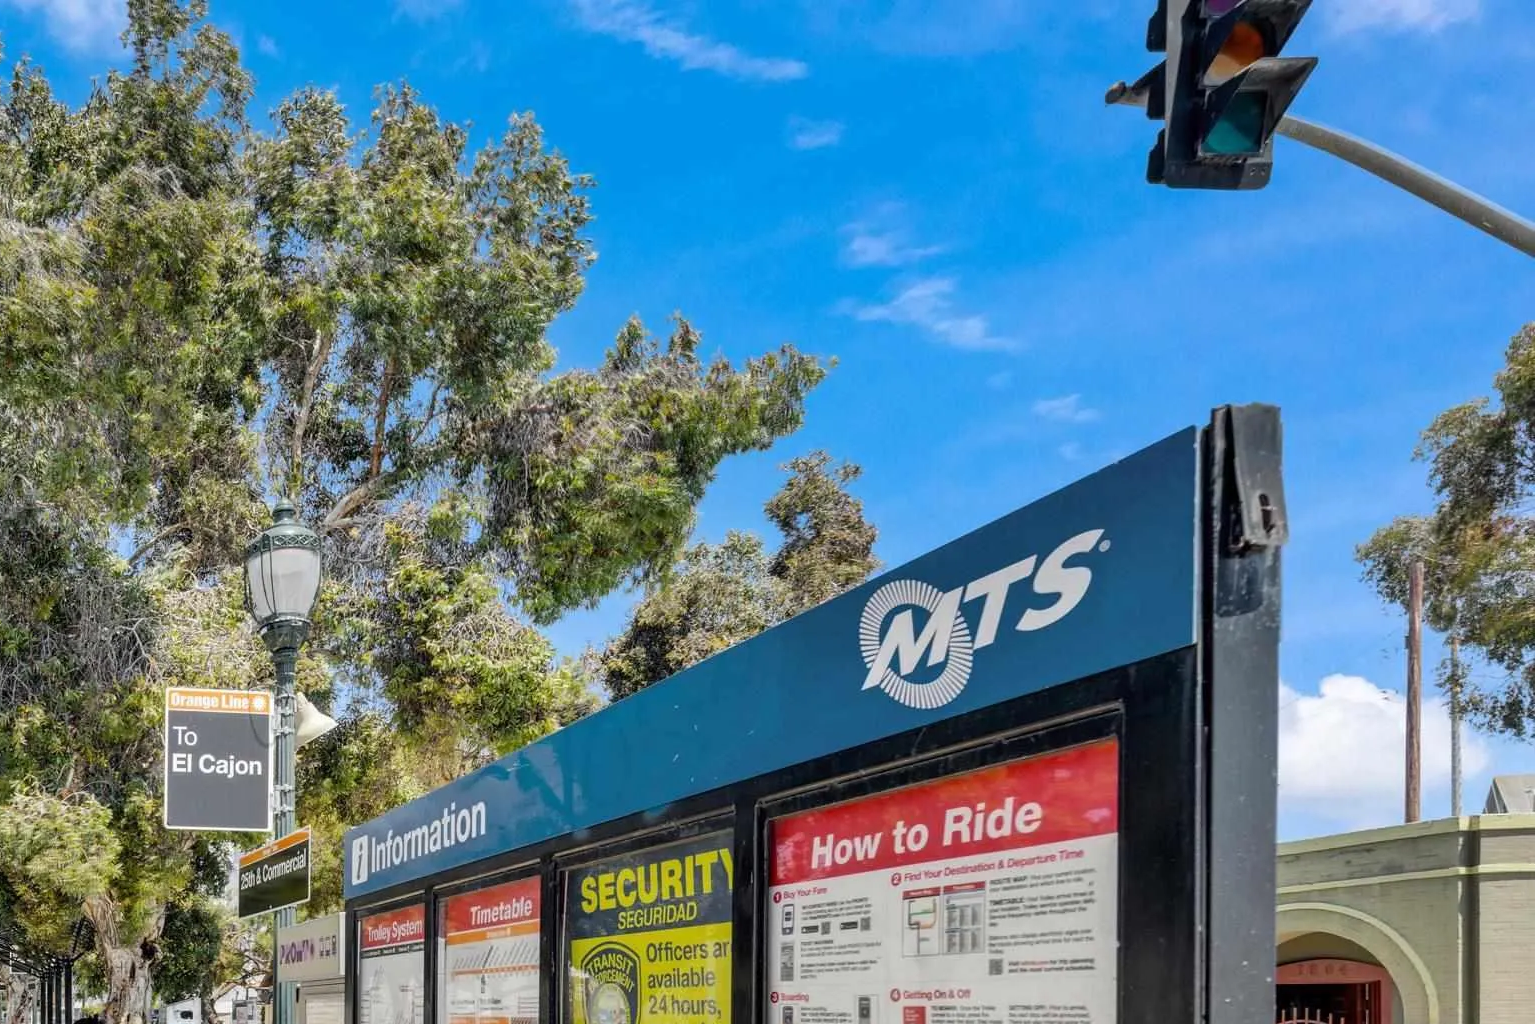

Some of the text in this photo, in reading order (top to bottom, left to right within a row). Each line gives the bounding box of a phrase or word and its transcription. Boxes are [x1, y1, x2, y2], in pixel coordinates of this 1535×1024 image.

[860, 528, 1106, 692] MTS
[170, 692, 250, 709] Orange Line
[172, 726, 198, 746] To
[172, 753, 262, 778] El Cajon
[371, 801, 486, 873] Information
[810, 797, 1044, 869] How to Ride
[240, 870, 256, 890] 25th
[256, 867, 262, 885] &
[262, 848, 307, 883] Commercial
[904, 872, 921, 880] Find
[923, 870, 942, 879] Your
[945, 862, 995, 876] Destination
[997, 859, 1004, 869] &
[1007, 853, 1056, 868] Departure
[1058, 849, 1084, 860] Time
[581, 849, 733, 914] SECURITY
[784, 891, 795, 900] Buy
[797, 889, 811, 897] Your
[470, 898, 533, 926] Timetable
[618, 901, 698, 930] SEGURIDAD
[368, 919, 423, 943] Trolley System
[646, 940, 709, 963] Officers
[587, 952, 633, 977] TRANSIT
[648, 968, 715, 989] available
[649, 995, 722, 1019] 24 hours,
[904, 991, 932, 1001] Getting
[934, 990, 946, 999] On
[957, 989, 971, 999] Off
